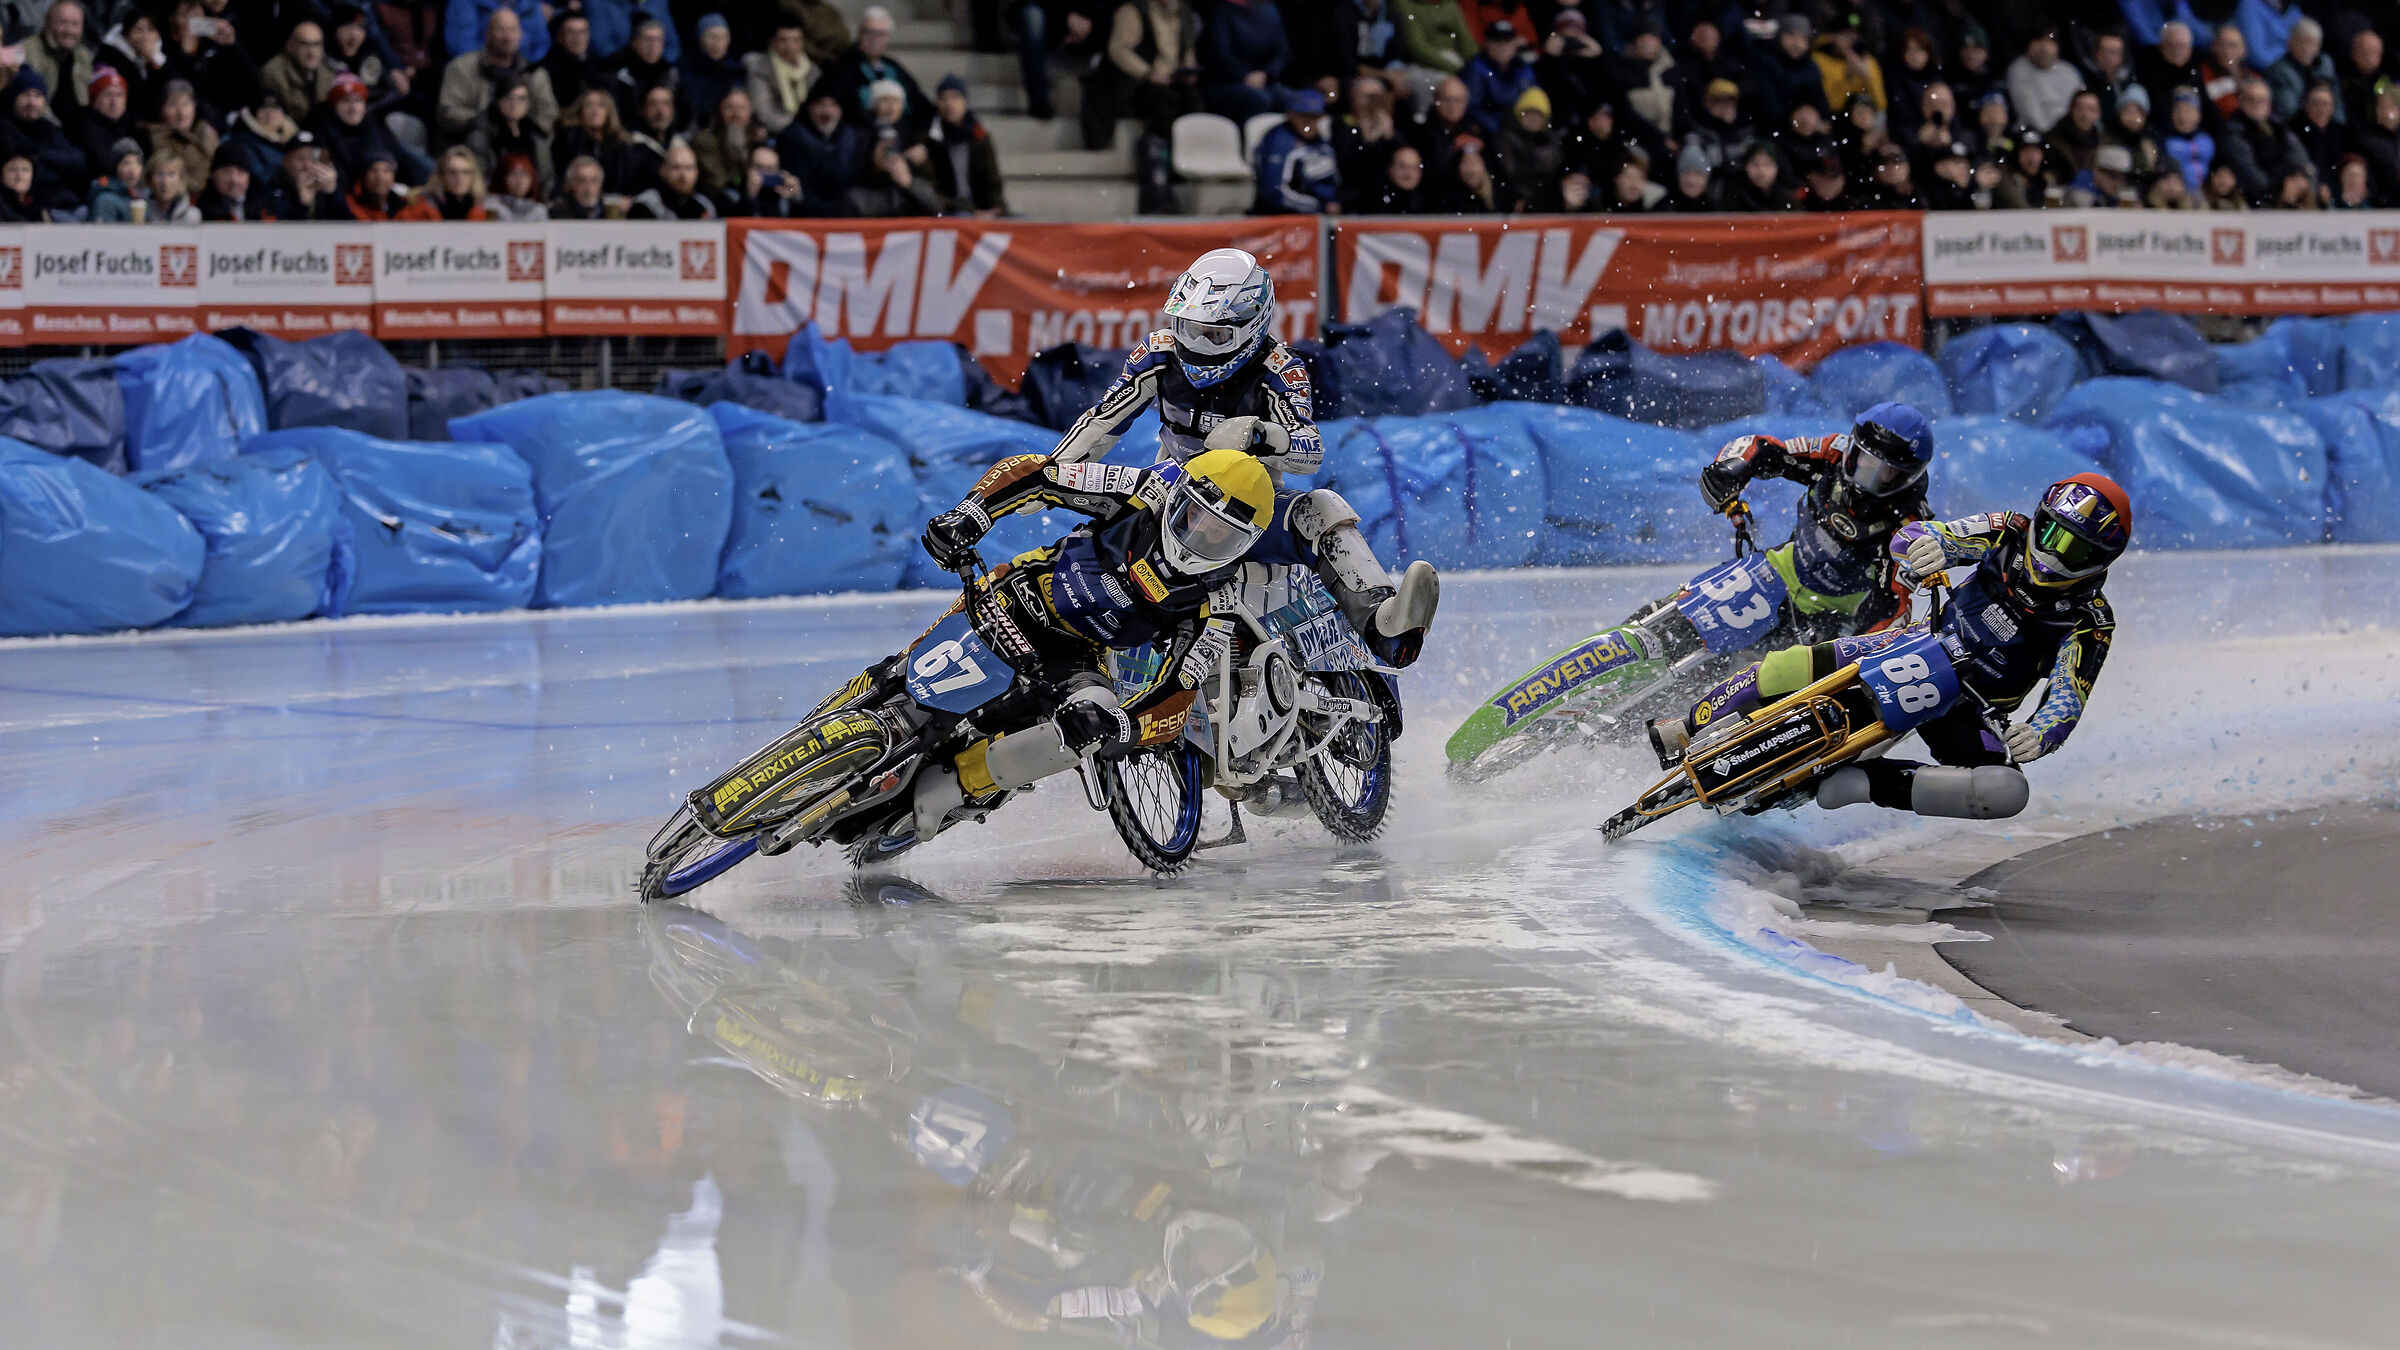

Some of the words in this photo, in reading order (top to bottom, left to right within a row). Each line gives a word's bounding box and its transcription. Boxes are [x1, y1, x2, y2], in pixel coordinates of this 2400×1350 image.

[34, 249, 89, 279] Josef
[96, 250, 155, 275] Fuchs
[208, 248, 264, 279] Josef
[270, 249, 330, 275] Fuchs
[384, 247, 436, 276] Josef
[443, 247, 501, 271] Fuchs
[555, 245, 610, 273] Josef
[615, 246, 674, 269] Fuchs
[1641, 294, 1918, 347] MOTORSPORT
[1062, 582, 1081, 609] ANLAS
[1699, 567, 1771, 629] 33
[913, 639, 987, 695] 67
[1507, 638, 1630, 715] RAVENOL
[1880, 653, 1941, 714] 88
[750, 738, 822, 788] RIXITE.fi
[1730, 746, 1761, 766] Stefan
[1758, 723, 1811, 752] KAPSNER.de
